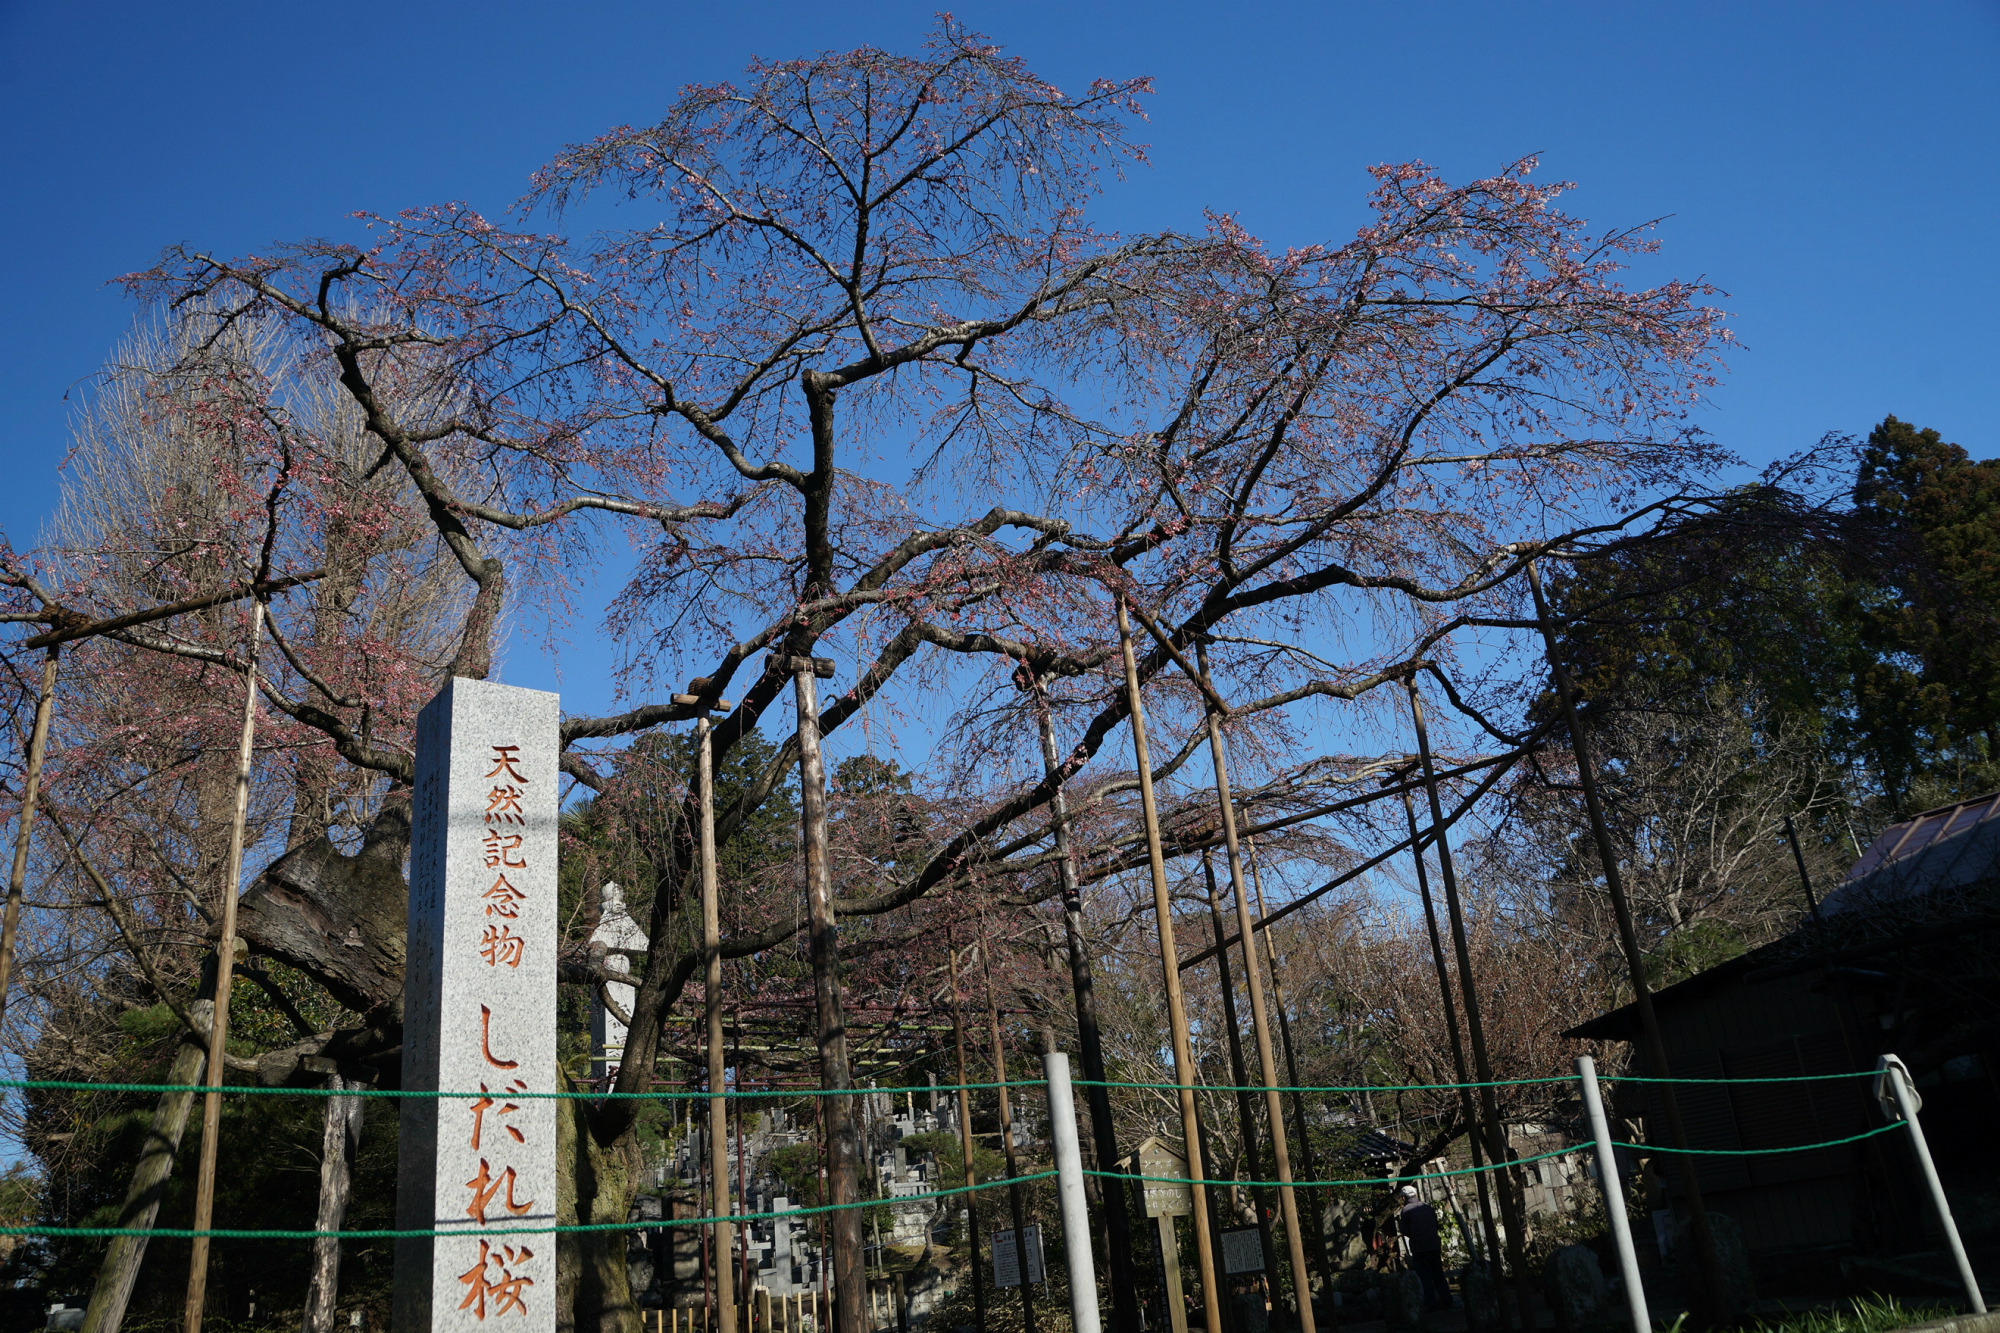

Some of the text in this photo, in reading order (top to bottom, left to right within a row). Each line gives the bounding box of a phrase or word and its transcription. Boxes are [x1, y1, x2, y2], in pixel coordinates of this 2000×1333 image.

[458, 745, 535, 1322] 天然記念物 しだれ桜
